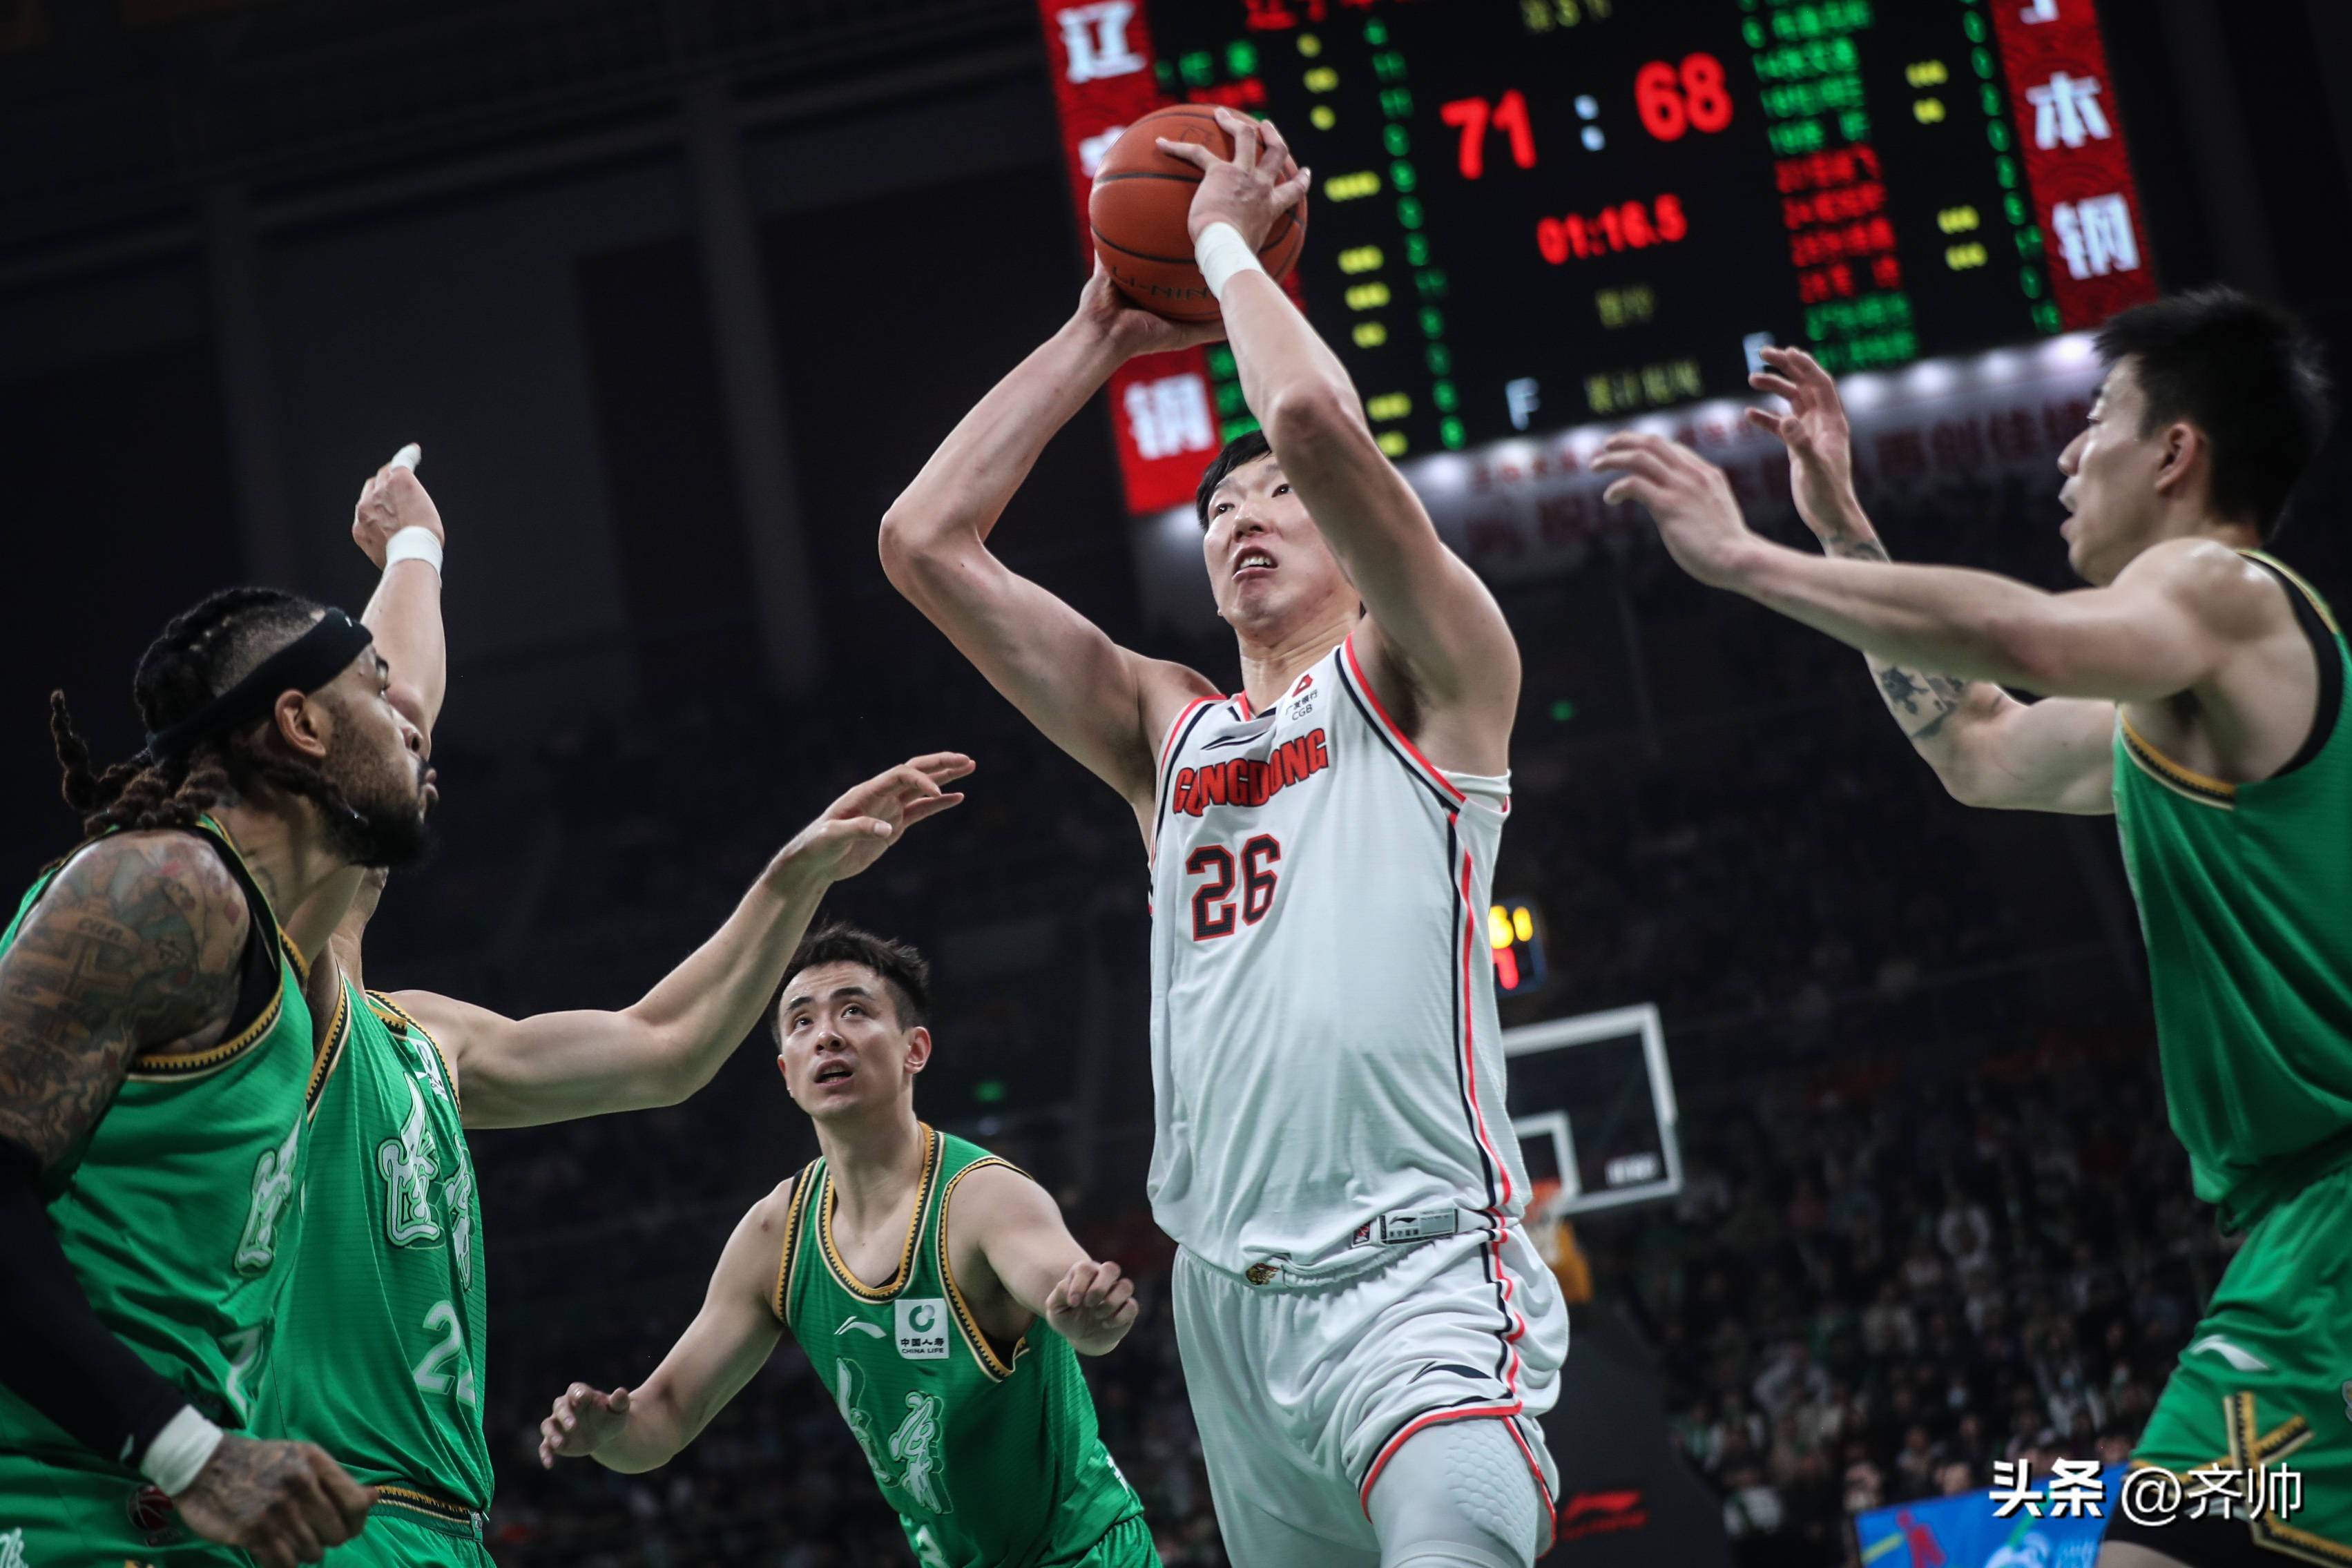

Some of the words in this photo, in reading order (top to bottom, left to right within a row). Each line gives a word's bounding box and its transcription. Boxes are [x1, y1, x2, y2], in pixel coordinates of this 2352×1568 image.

[1440, 88, 1537, 180] 71
[1634, 52, 1734, 142] 68
[1111, 265, 1209, 300] LI-NIN
[1292, 704, 1313, 721] CGB
[1185, 833, 1282, 942] 26
[900, 1337, 945, 1348] 中国人寿
